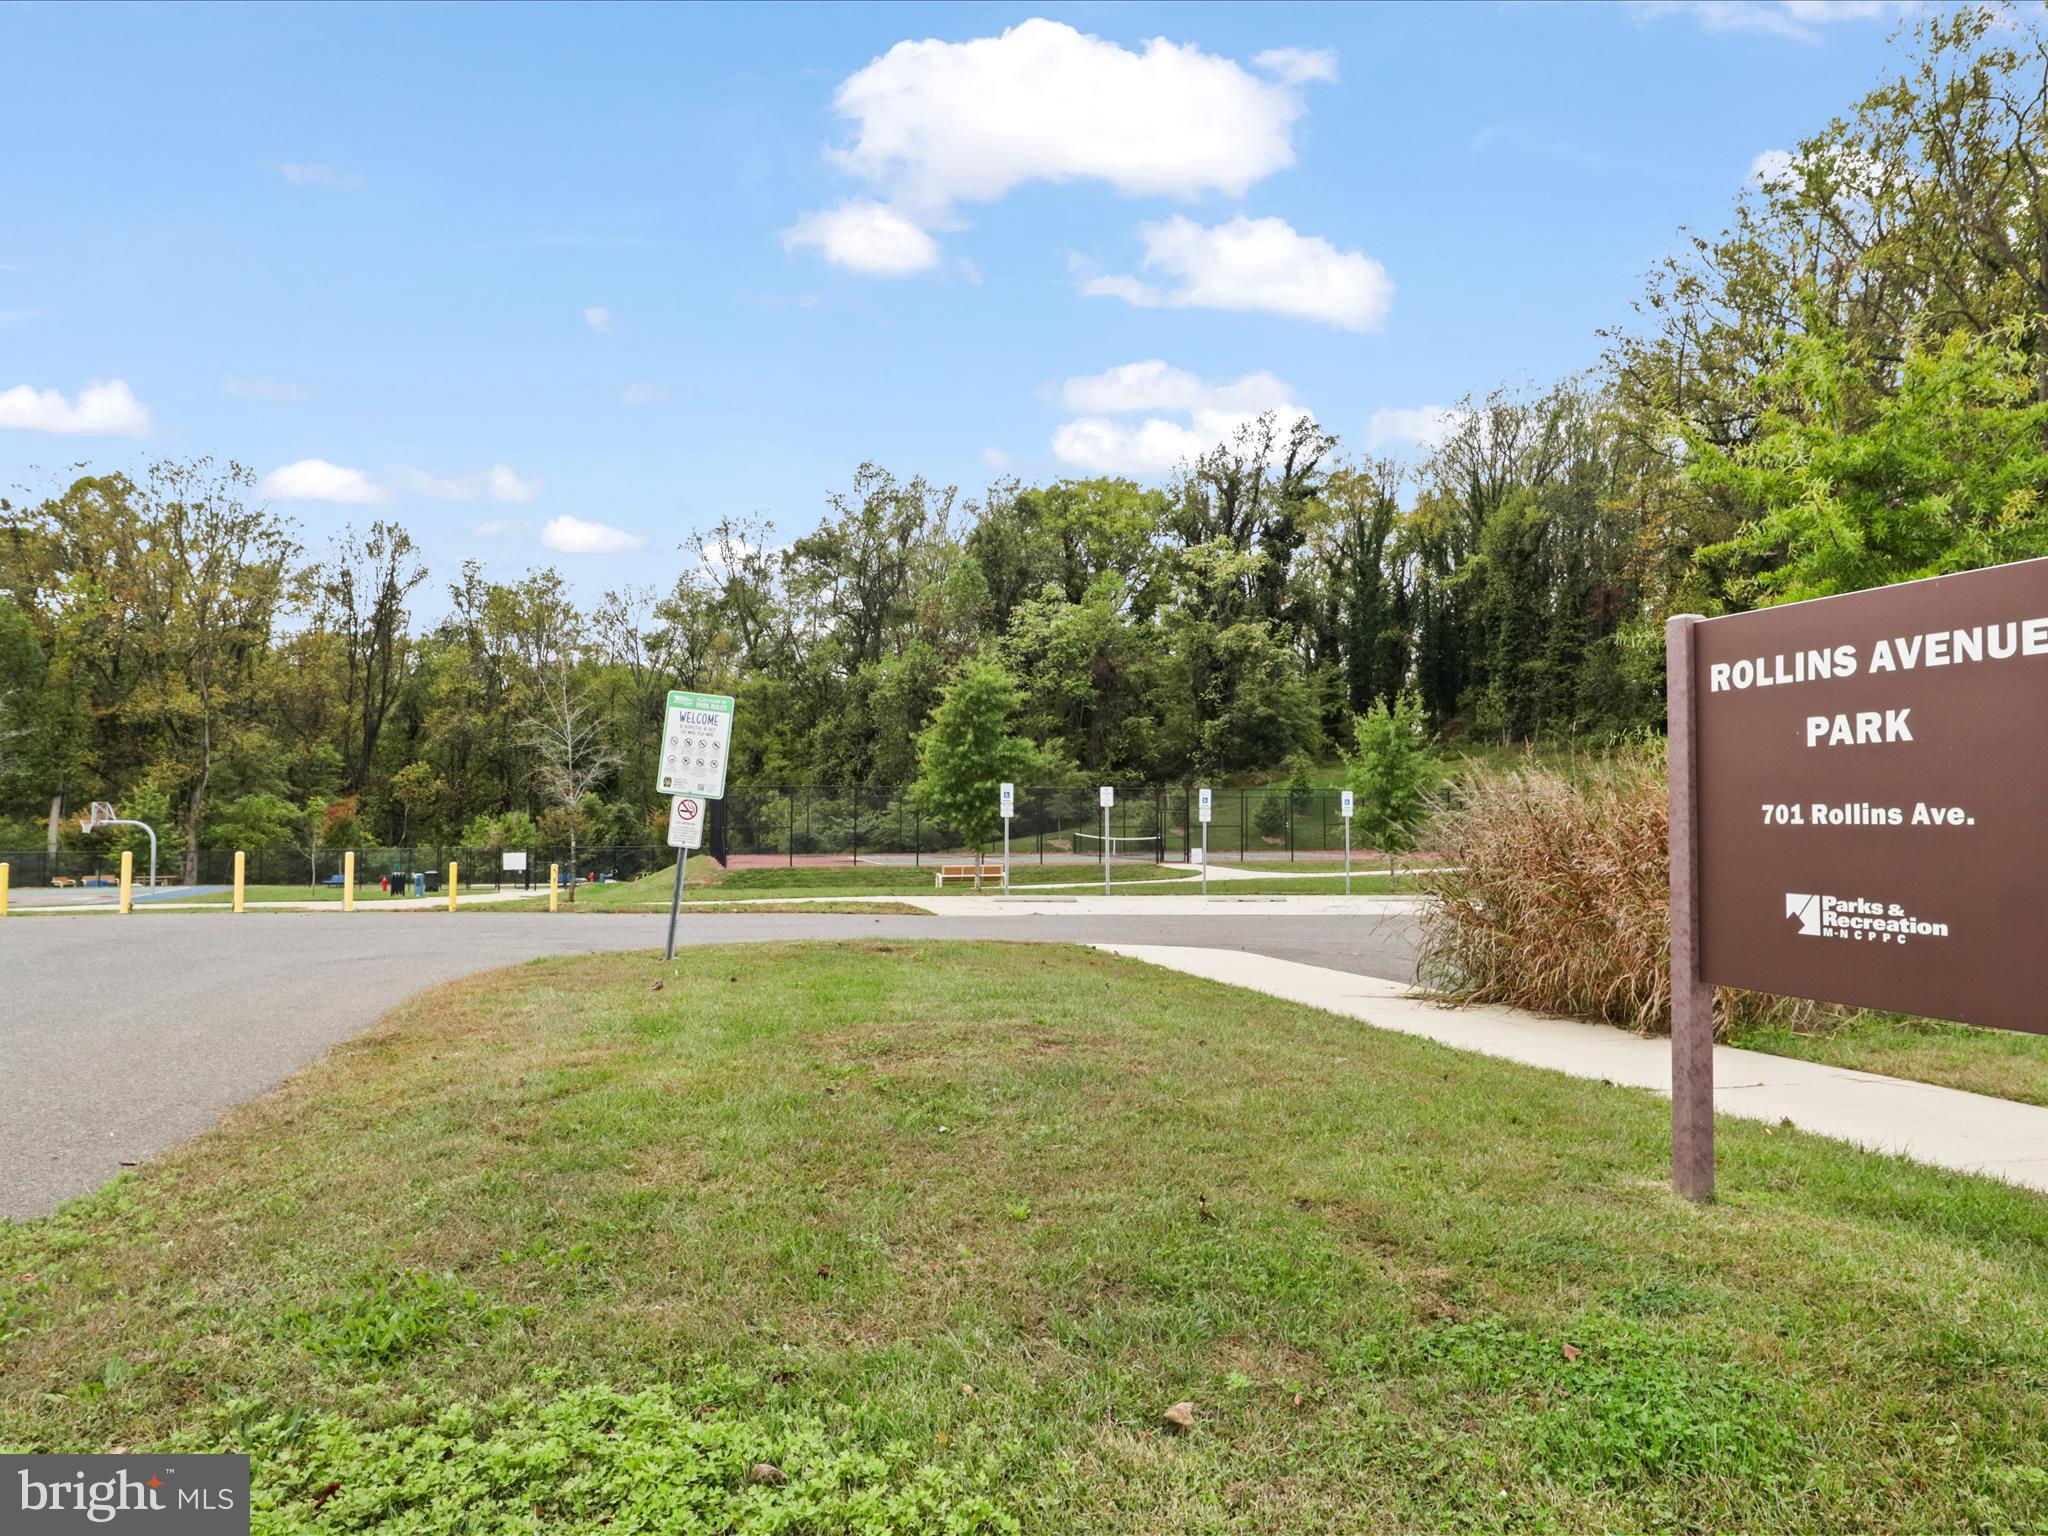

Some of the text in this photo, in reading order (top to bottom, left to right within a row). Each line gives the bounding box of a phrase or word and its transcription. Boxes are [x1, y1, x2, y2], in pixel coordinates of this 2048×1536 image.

[1710, 617, 2048, 693] ROLLINS AVENUE
[679, 710, 720, 726] WELCOME
[1806, 708, 1914, 748] PARK
[1761, 802, 1975, 826] 701 Rollins Ave.
[1822, 895, 1905, 917] Parks &
[1822, 910, 1949, 937] Recreation
